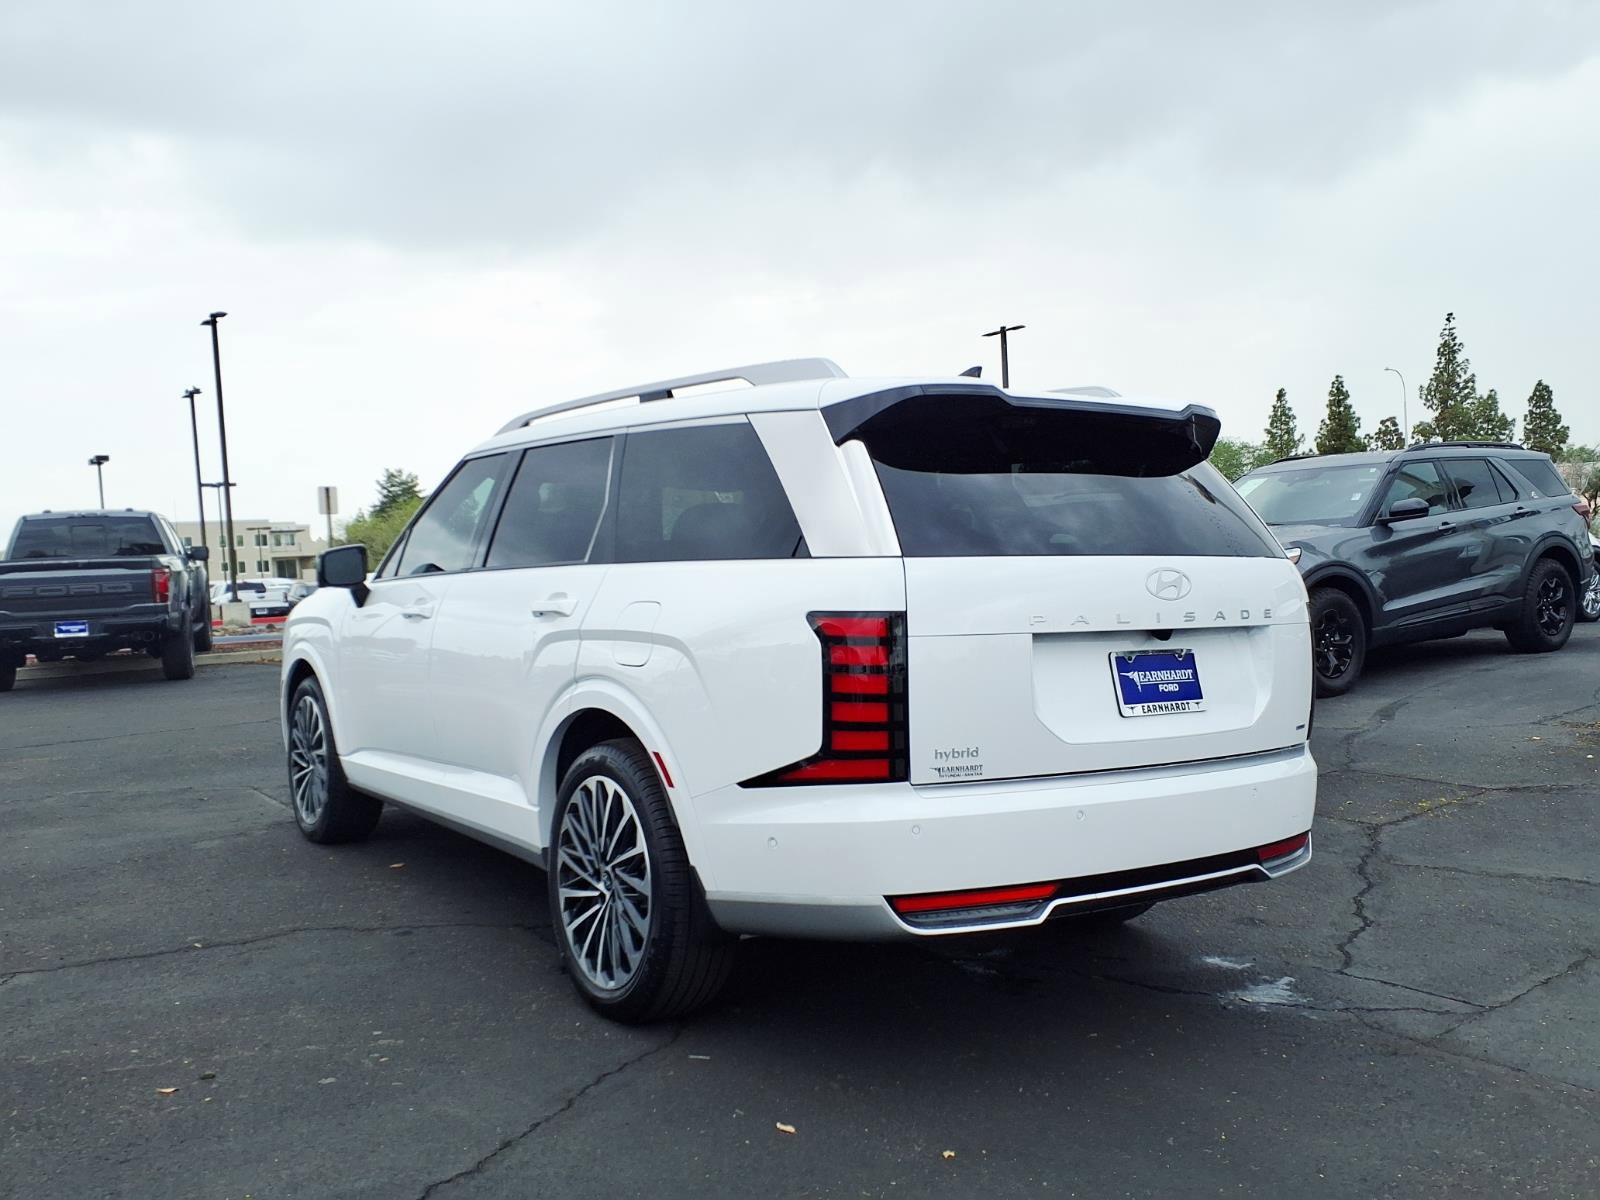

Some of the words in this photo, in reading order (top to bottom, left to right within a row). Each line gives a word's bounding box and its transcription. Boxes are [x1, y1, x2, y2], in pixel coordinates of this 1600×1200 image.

[2, 583, 133, 597] FORD
[1029, 608, 1274, 626] PALISADE
[1139, 669, 1193, 681] EARNHARDT
[1159, 684, 1179, 692] FORD
[1141, 702, 1191, 714] EARNHARDT
[934, 746, 979, 762] hybrid
[940, 764, 983, 773] EARNHARDT
